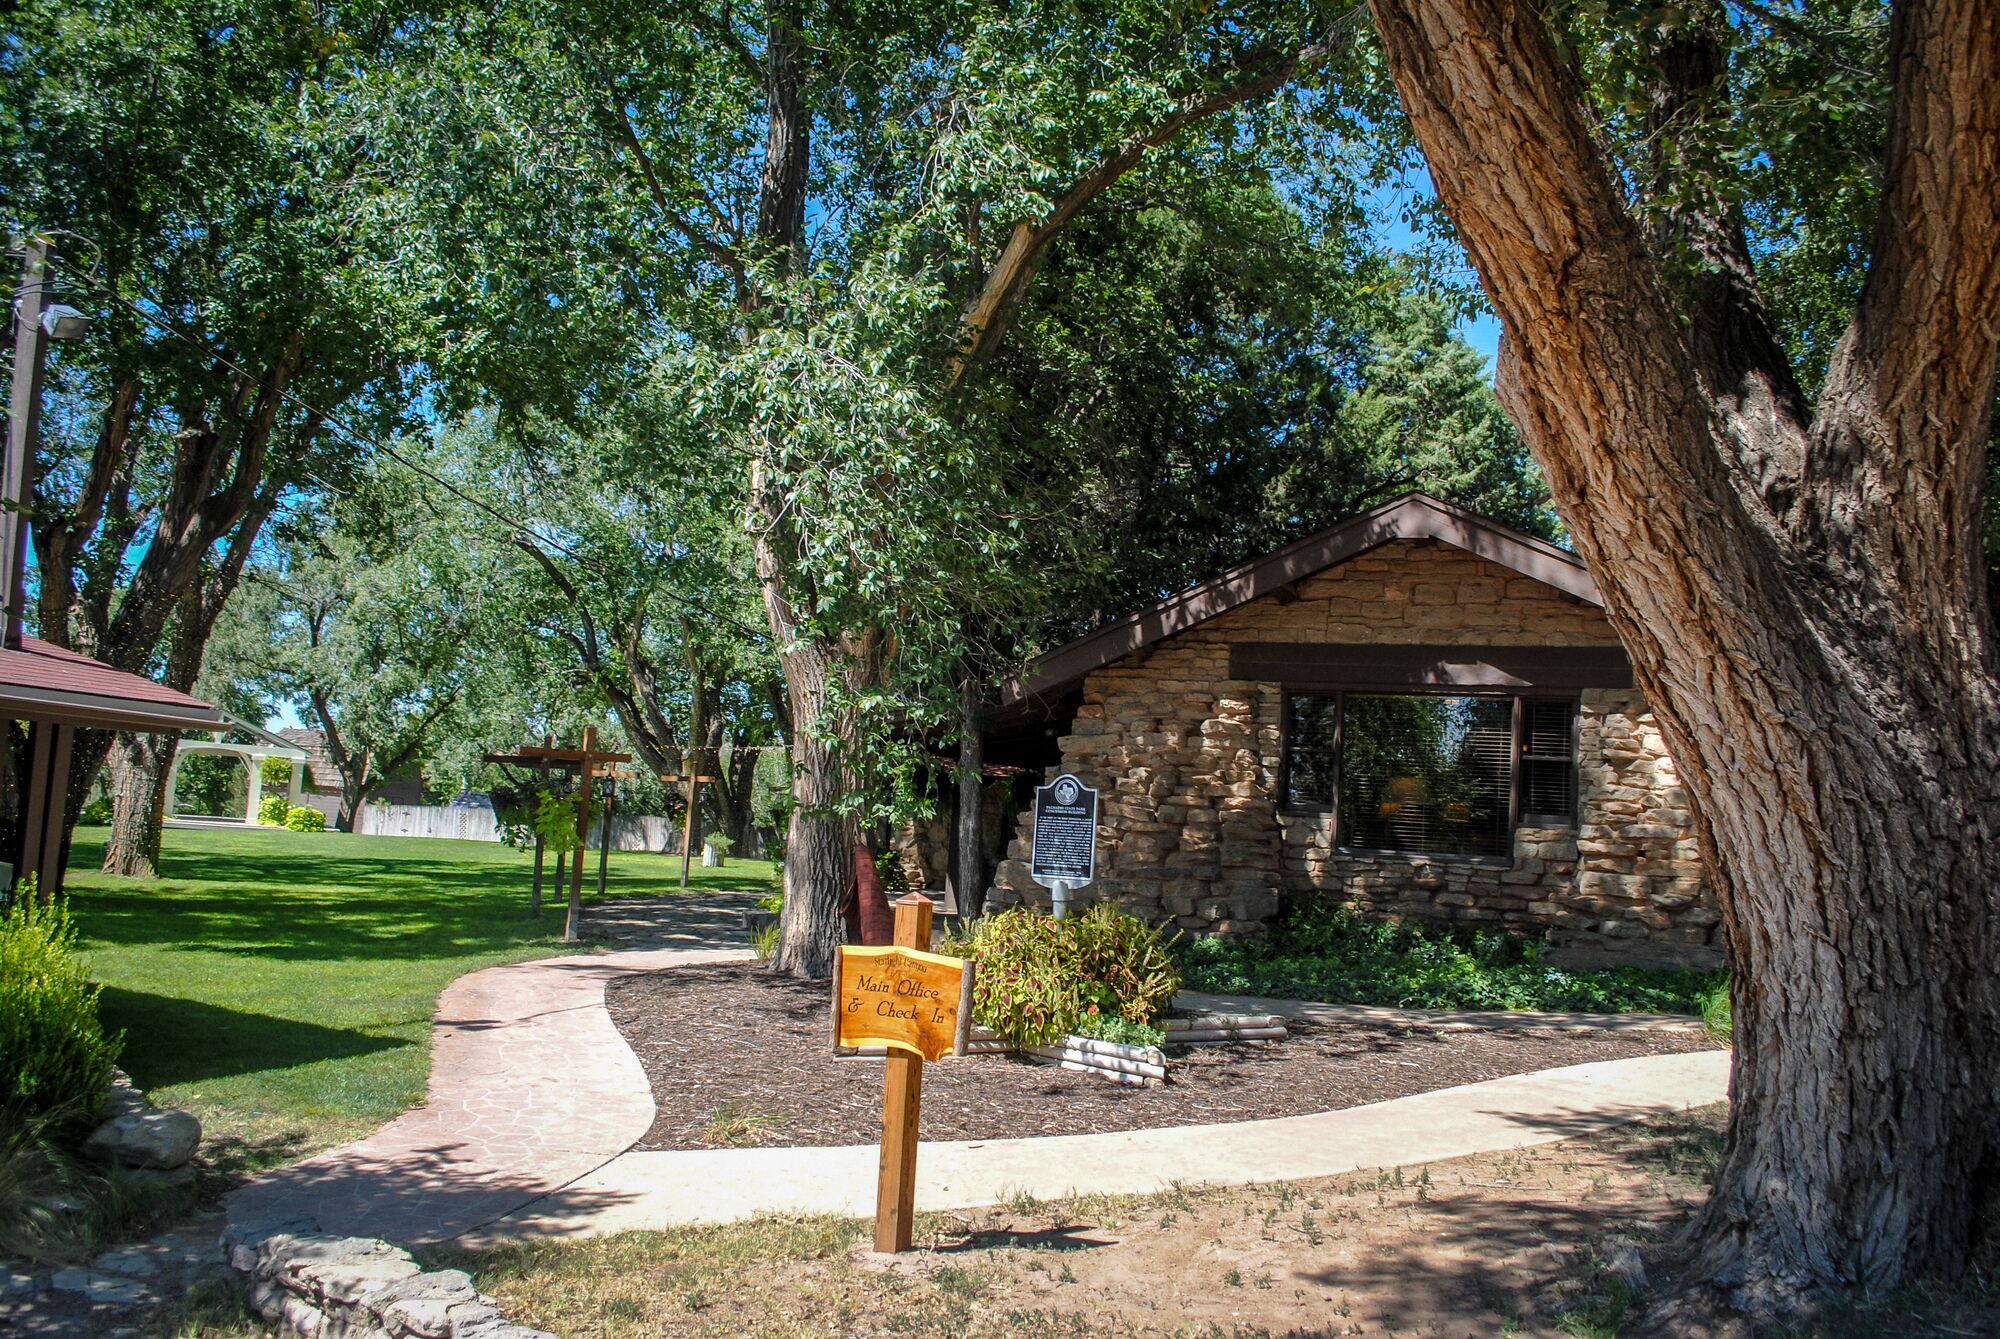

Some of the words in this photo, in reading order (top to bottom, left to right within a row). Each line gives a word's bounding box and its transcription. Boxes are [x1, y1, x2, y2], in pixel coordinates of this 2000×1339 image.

[855, 975, 890, 993] Main
[897, 979, 939, 999] Office
[848, 997, 864, 1013] &
[877, 1000, 920, 1020] Check
[931, 1008, 945, 1023] In
